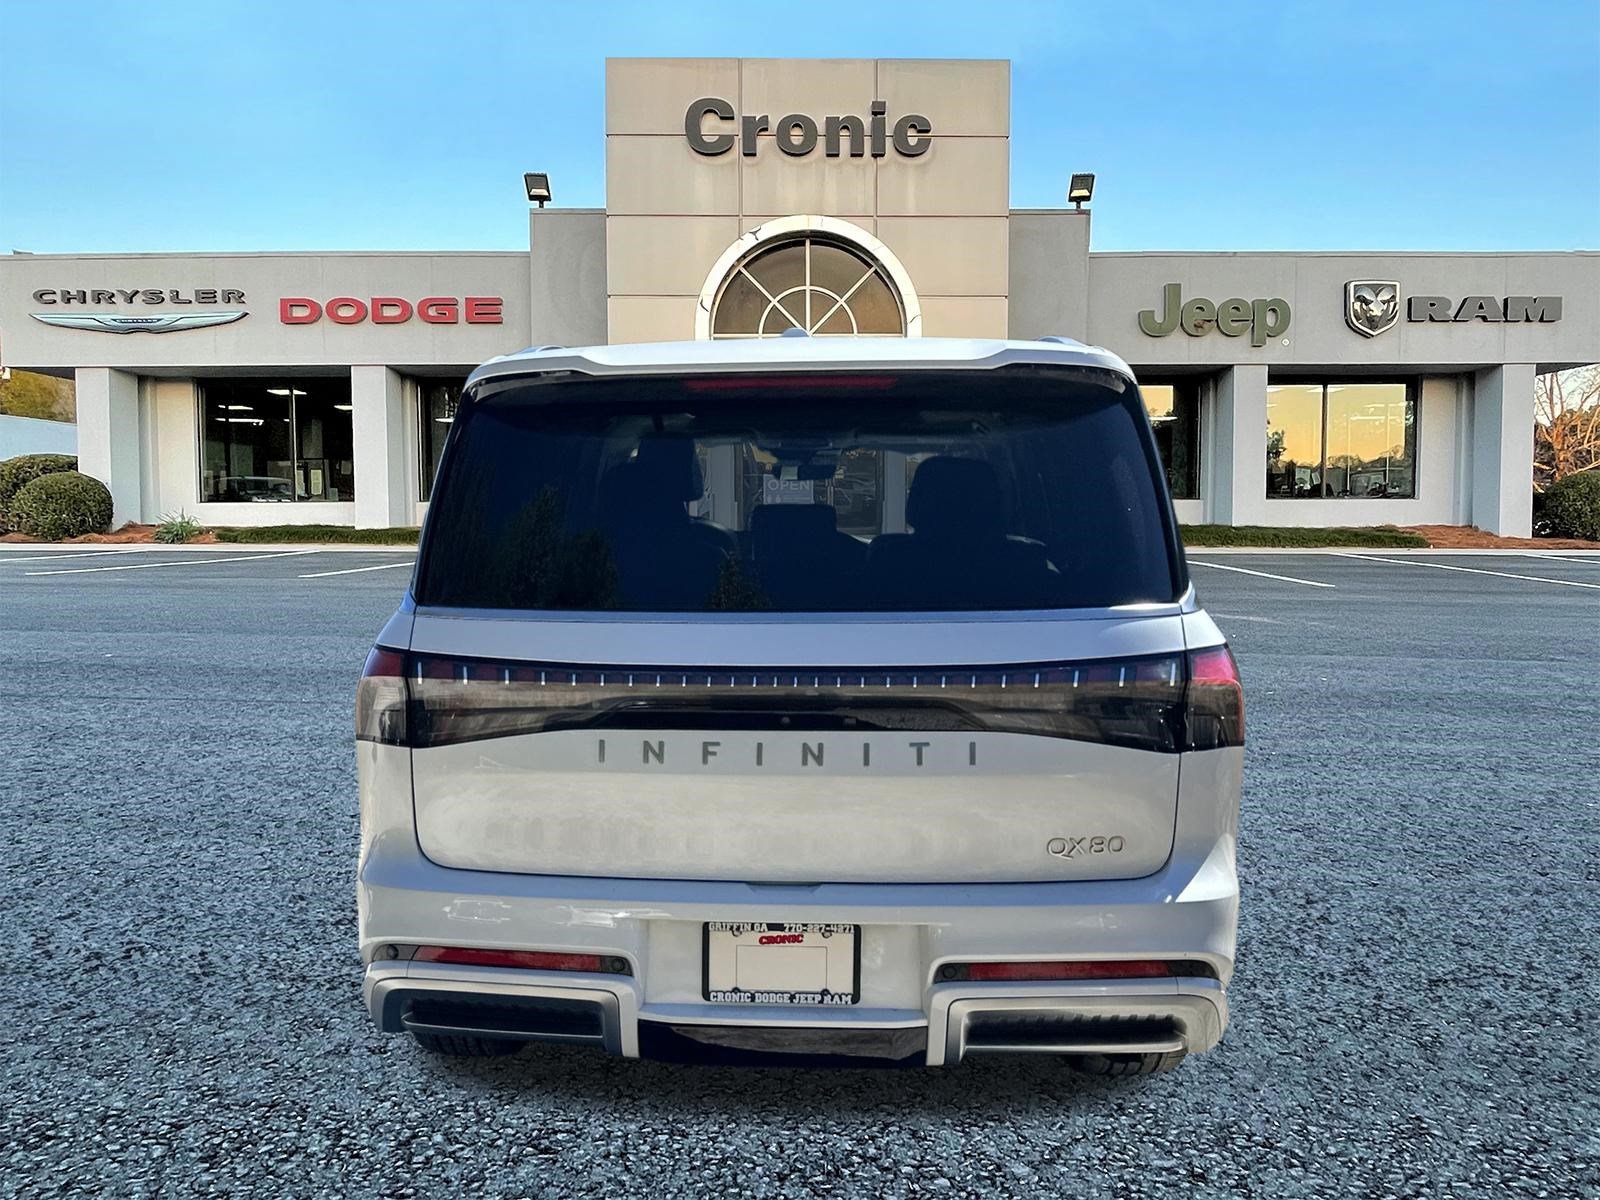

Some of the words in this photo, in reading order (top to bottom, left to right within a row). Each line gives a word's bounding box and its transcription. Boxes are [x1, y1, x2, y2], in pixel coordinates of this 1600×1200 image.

[685, 97, 932, 158] Cronic
[32, 289, 246, 304] CHRYSLER
[279, 296, 504, 325] DODGE
[1138, 283, 1291, 347] Jeep
[1407, 296, 1562, 323] RAM
[767, 479, 810, 491] OPEN
[598, 739, 977, 767] INFINITI
[1046, 835, 1126, 860] QX80
[708, 922, 752, 932] GRIFFIN
[753, 923, 769, 933] GA
[758, 934, 805, 946] CRONIC
[709, 991, 752, 1003] CRONIC
[754, 992, 791, 1004] DODGE
[792, 993, 822, 1004] JEEP
[823, 993, 853, 1005] RAM
